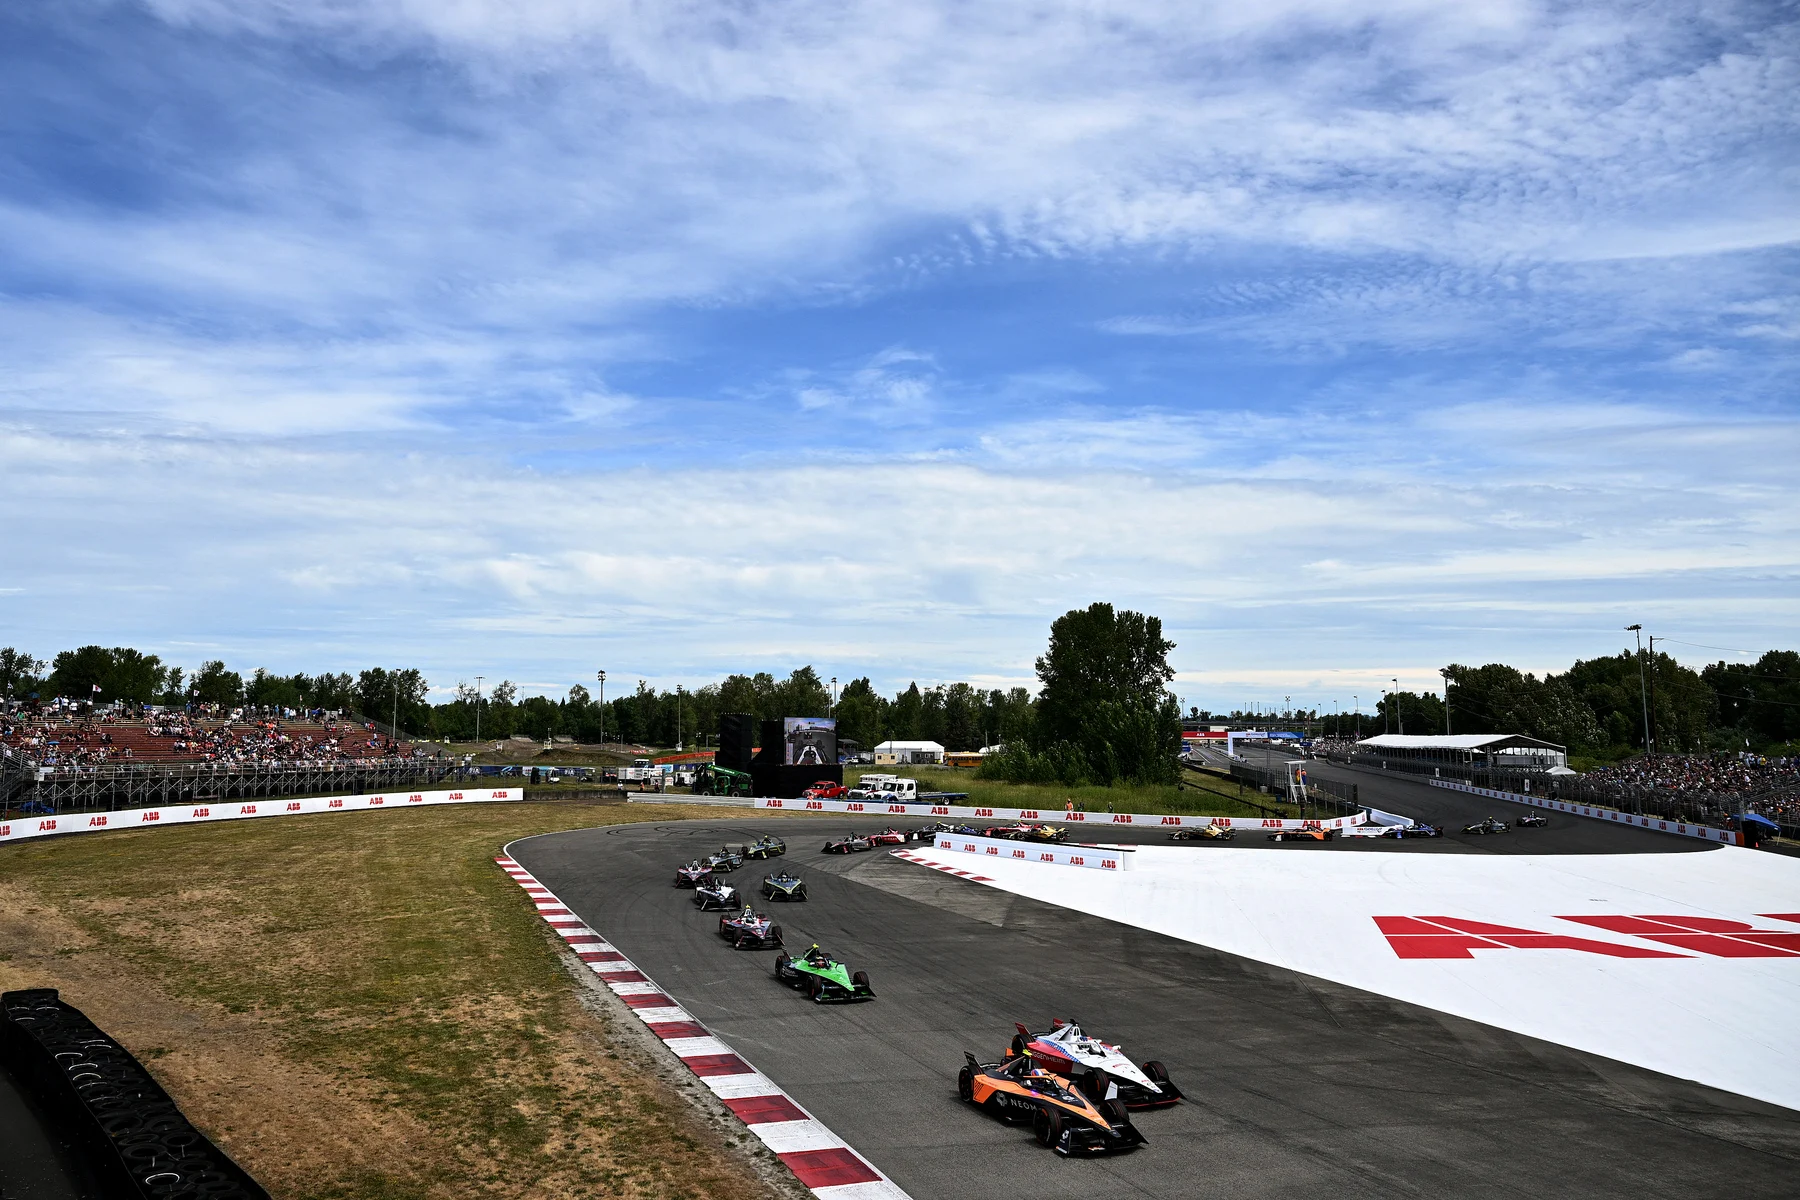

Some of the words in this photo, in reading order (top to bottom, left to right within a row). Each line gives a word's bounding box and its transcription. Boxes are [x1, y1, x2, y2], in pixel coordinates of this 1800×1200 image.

[39, 820, 57, 831] ABB
[89, 816, 107, 827] ABB
[142, 811, 160, 822] ABB
[193, 808, 210, 818] ABB
[240, 805, 257, 815] ABB
[287, 802, 301, 811] ABB
[329, 799, 343, 808] ABB
[369, 797, 384, 805] ABB
[766, 800, 783, 808] ABB
[806, 801, 823, 810] ABB
[847, 803, 864, 812] ABB
[888, 805, 906, 813] ABB
[931, 807, 949, 815] ABB
[975, 808, 993, 817] ABB
[1020, 810, 1039, 819] ABB
[1066, 812, 1085, 821] ABB
[1113, 815, 1132, 824] ABB
[1161, 817, 1182, 826] ABB
[1211, 818, 1232, 827] ABB
[1262, 819, 1283, 828] ABB
[1659, 821, 1667, 830] ABB
[1678, 825, 1686, 834] ABB
[1697, 828, 1707, 837] ABB
[1719, 831, 1729, 842] ABB
[940, 841, 952, 849] ABB
[964, 844, 976, 852] ABB
[986, 847, 998, 855] ABB
[1013, 850, 1025, 858] ABB
[1041, 853, 1054, 862] ABB
[1070, 856, 1084, 865] ABB
[1102, 859, 1116, 869] ABB
[1371, 913, 1800, 960] AB
[1010, 1098, 1038, 1111] NEOM
